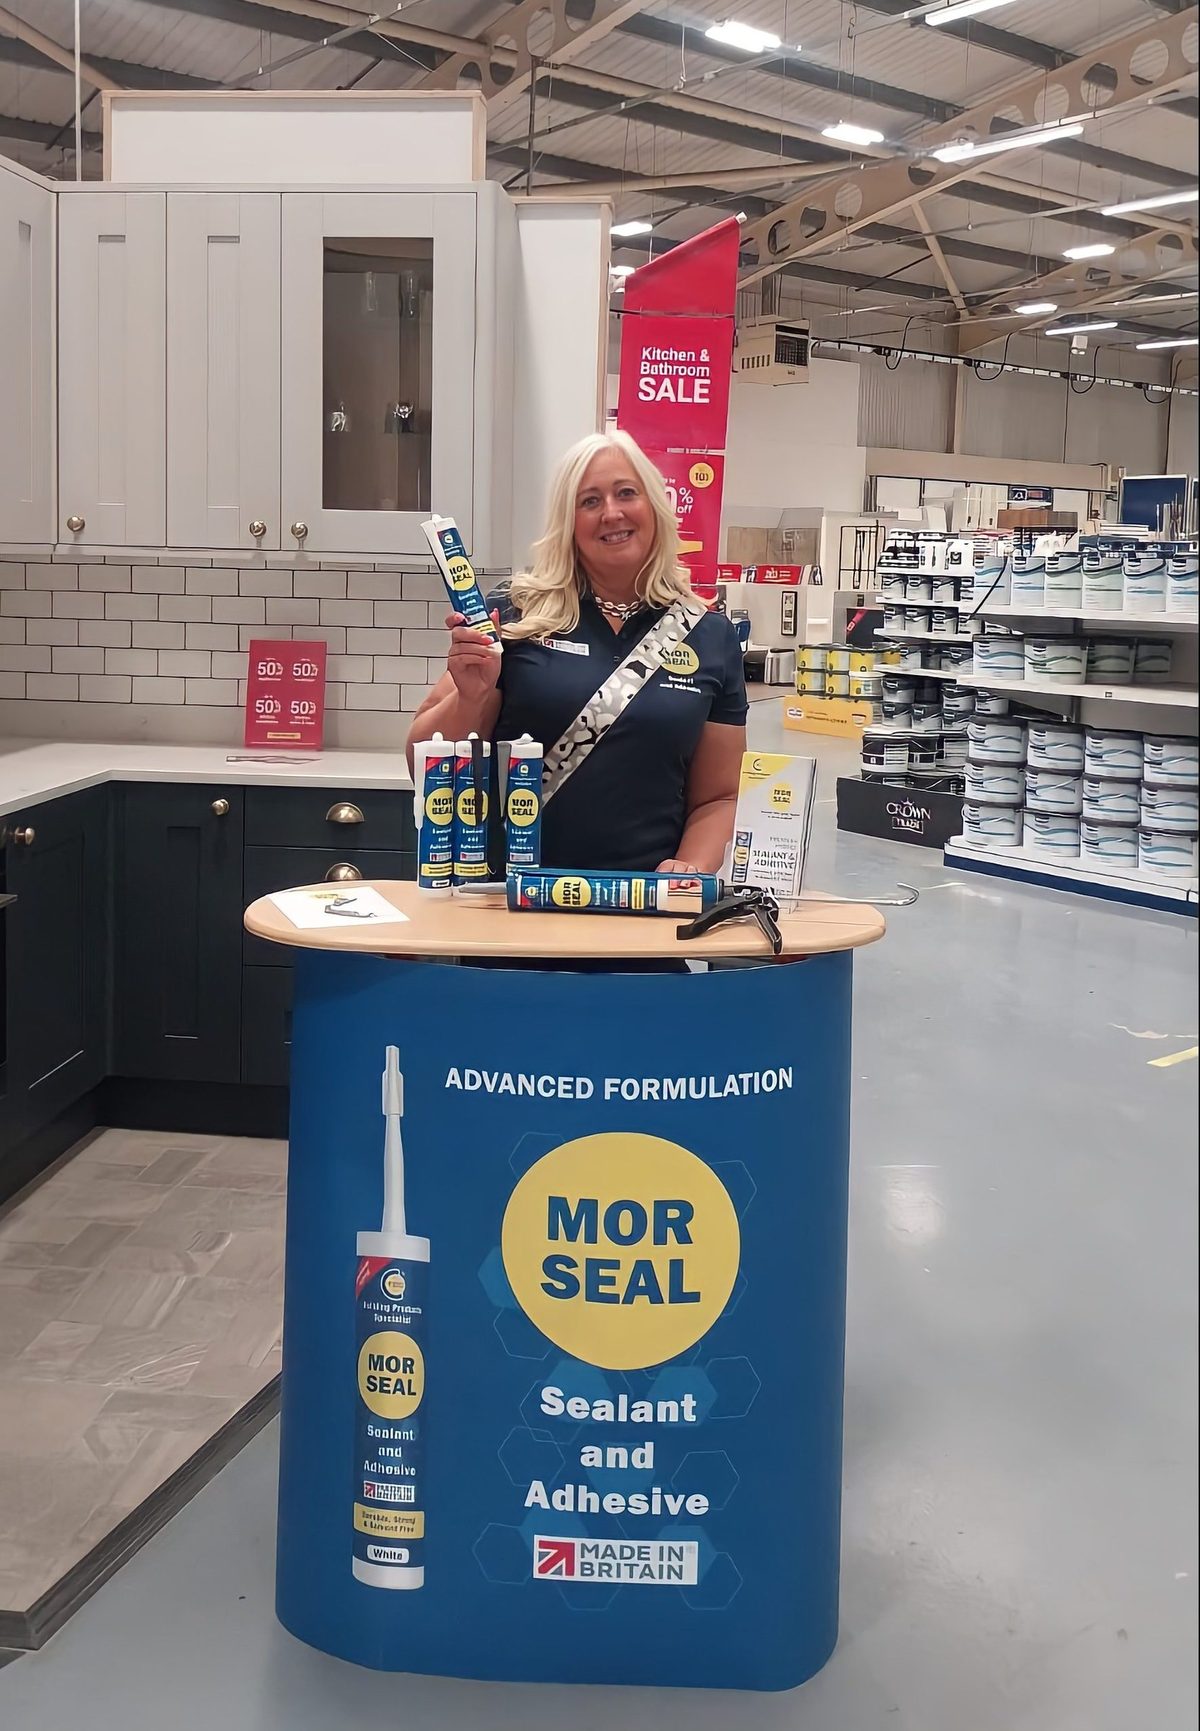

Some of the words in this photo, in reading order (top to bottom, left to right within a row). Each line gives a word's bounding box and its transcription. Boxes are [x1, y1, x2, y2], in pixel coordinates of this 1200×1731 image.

[641, 346, 696, 362] Kitchen
[699, 348, 710, 362] &
[640, 361, 710, 377] Bathroom
[637, 377, 711, 404] SALE
[886, 802, 931, 820] CROWN
[444, 1066, 595, 1100] ADVANCED
[603, 1066, 794, 1101] FORMULATION
[547, 1195, 695, 1247] MOR
[540, 1254, 702, 1305] SEAL
[368, 1353, 415, 1375] MOR
[366, 1375, 417, 1396] SEAL
[540, 1385, 697, 1423] Sealant
[378, 1446, 402, 1458] and
[580, 1441, 655, 1469] and
[524, 1479, 710, 1516] Adhesive
[373, 1547, 403, 1561] White
[579, 1542, 651, 1562] MADE
[658, 1545, 684, 1562] IN
[579, 1561, 684, 1581] BRITAIN
